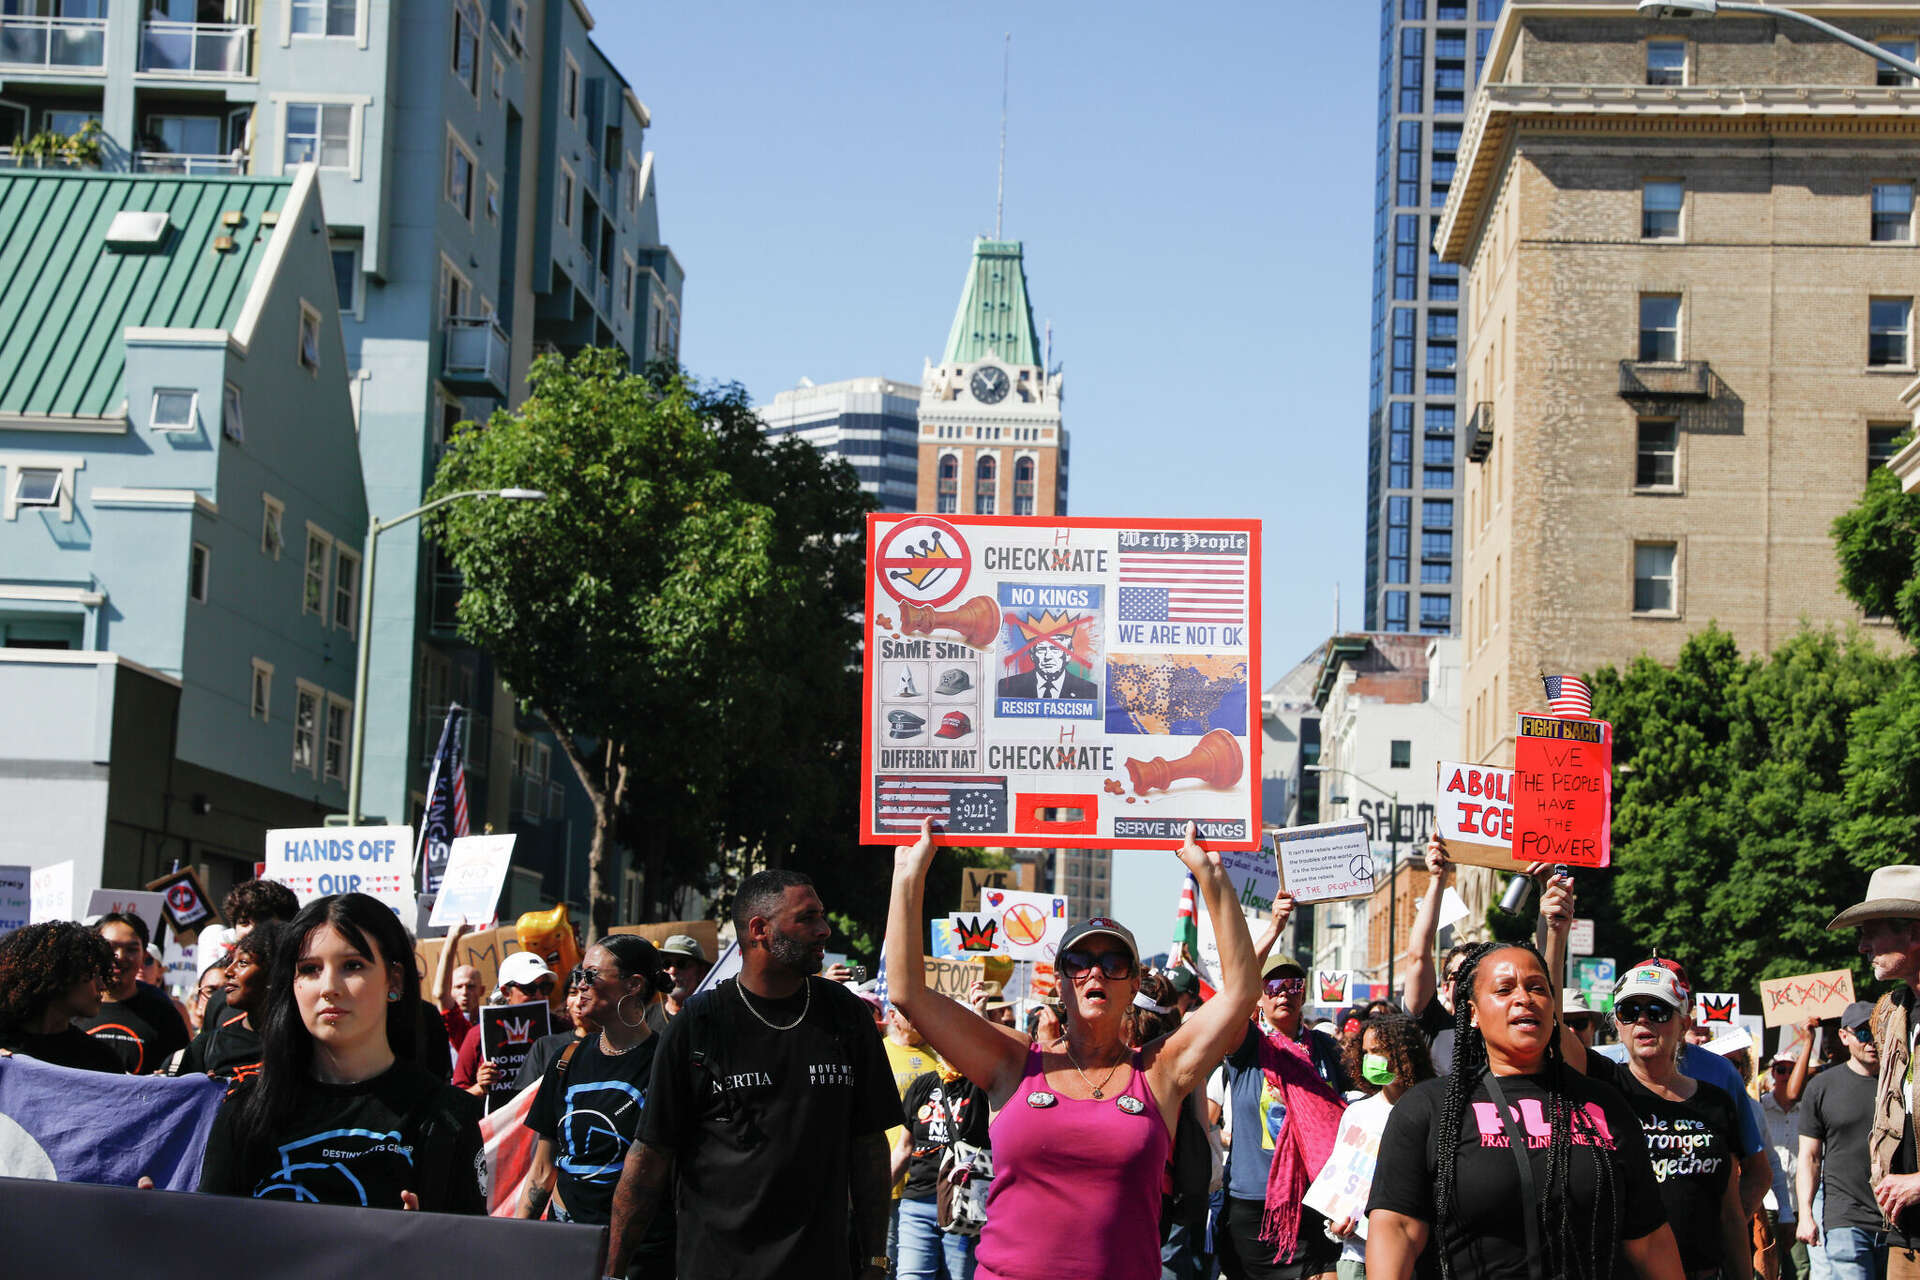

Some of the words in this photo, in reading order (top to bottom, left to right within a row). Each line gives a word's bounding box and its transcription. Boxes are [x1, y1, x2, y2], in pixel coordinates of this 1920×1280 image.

[1120, 531, 1149, 546] We
[1152, 533, 1180, 550] the
[1182, 533, 1245, 551] People
[984, 546, 1108, 572] CHECKMATE
[1011, 588, 1036, 605] NO
[1038, 589, 1089, 606] KINGS
[1119, 624, 1144, 643] WE
[1150, 625, 1181, 644] ARE
[1186, 626, 1216, 645] NOT
[1223, 627, 1243, 645] OK
[882, 640, 931, 659] SAME
[1002, 701, 1041, 714] RESIST
[1043, 702, 1093, 716] FASCISM
[1522, 718, 1560, 737] FIGHT
[1563, 721, 1598, 741] BACK
[881, 750, 948, 769] DIFFERENT
[951, 750, 977, 769] HAT
[989, 745, 1113, 771] CHECKMATE
[1543, 744, 1583, 767] WE
[1515, 771, 1544, 792] THE
[1552, 773, 1600, 792] PEOPLE
[1537, 798, 1576, 812] HAVE
[1115, 821, 1165, 835] SERVE
[1198, 824, 1244, 837] KINGS
[1544, 818, 1573, 832] THE
[284, 839, 354, 862] HANDS
[358, 840, 396, 863] OFF
[1522, 831, 1596, 858] POWER
[318, 873, 361, 896] OUR
[1306, 885, 1321, 895] THE
[809, 1063, 837, 1074] MOVE
[1673, 1119, 1704, 1131] are
[1644, 1132, 1713, 1155] ronger
[322, 1148, 361, 1159] DESTINY
